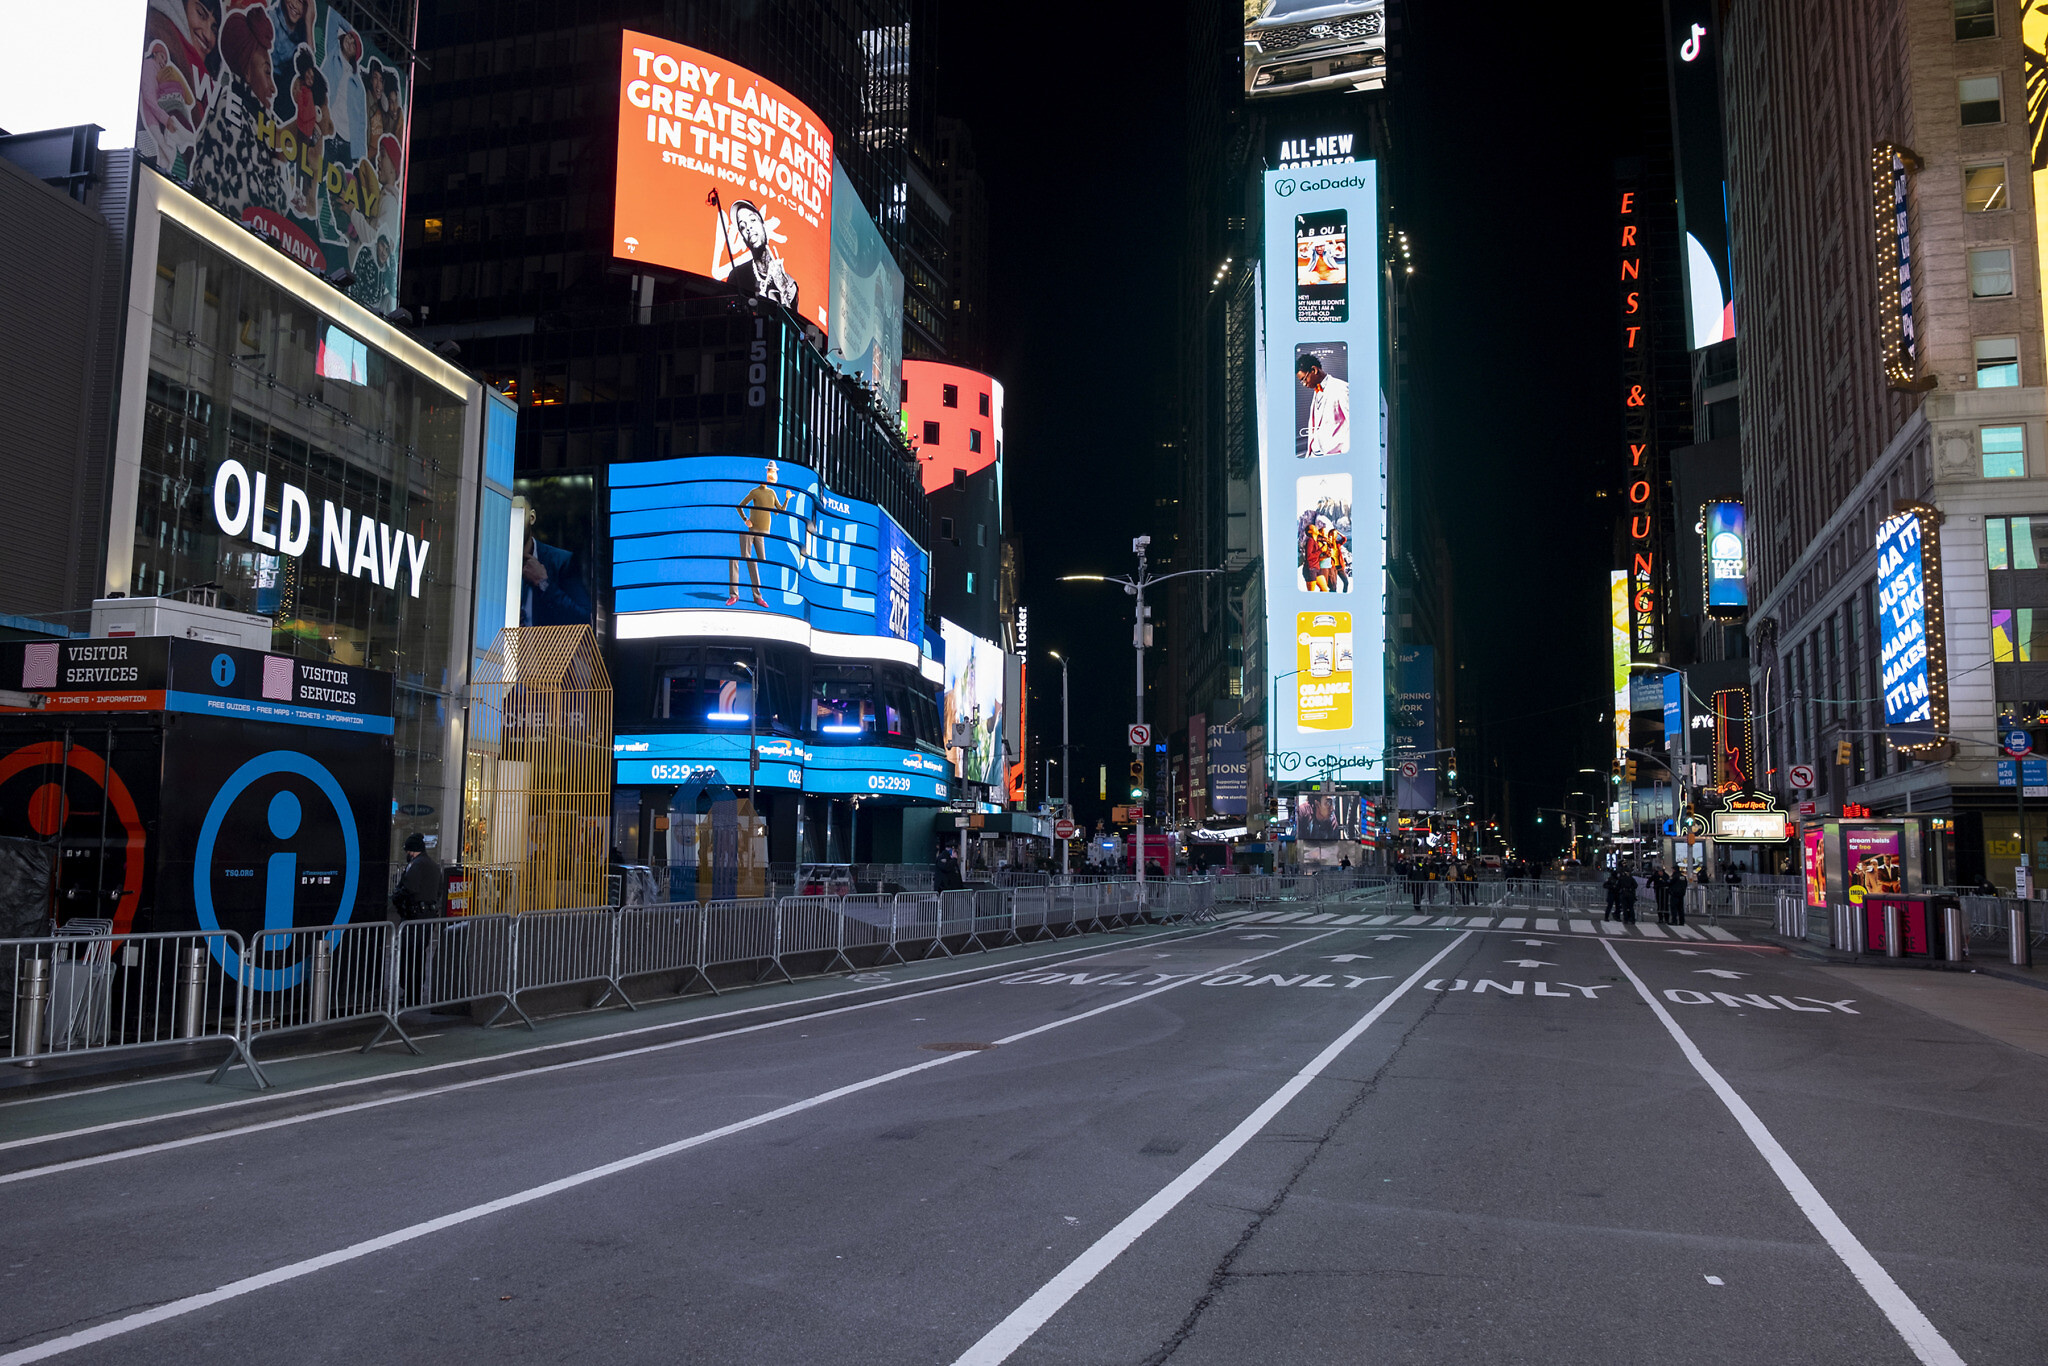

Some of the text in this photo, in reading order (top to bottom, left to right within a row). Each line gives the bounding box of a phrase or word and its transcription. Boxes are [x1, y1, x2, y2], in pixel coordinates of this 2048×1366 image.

[192, 64, 243, 129] WE
[633, 48, 831, 168] TORY LANEZ THE
[627, 79, 831, 197] GREATEST ARTIST
[1280, 134, 1353, 160] ALL-NEW
[256, 111, 379, 217] HOLIDAY
[647, 114, 824, 219] IN THE WORLD.
[662, 151, 746, 187] STREAM NOW
[1300, 175, 1366, 191] GoDaddy
[253, 215, 319, 268] OLD NAVY
[1620, 192, 1641, 348] ERNST
[748, 318, 767, 407] 1500
[214, 459, 430, 599] OLD NAVY
[1629, 443, 1654, 613] YOUNG
[1898, 517, 1921, 553] IT!
[1711, 559, 1744, 569] TACO
[1714, 568, 1745, 579] BELL
[1879, 561, 1916, 615] JUST
[889, 589, 909, 641] 2021
[68, 645, 129, 661] VISITOR
[1881, 618, 1922, 666] MAMA
[66, 667, 138, 682] SERVICES
[300, 665, 349, 685] VISITOR
[1882, 639, 1927, 690] MAKES
[300, 685, 356, 705] SERVICES
[1300, 682, 1350, 696] ORANGE
[1300, 695, 1333, 708] CORN
[1887, 682, 1910, 716] IT!
[207, 700, 364, 725] FREE GUIDES FREE MAPS TICKETS INFORMATION
[1305, 754, 1375, 770] GoDaddy
[868, 775, 911, 791] 05:29:39
[1733, 801, 1766, 809] Hard Rock
[1986, 840, 2020, 855] 150
[225, 869, 254, 877] TSQ.ORG
[448, 882, 472, 893] JERSEY
[1000, 972, 1206, 986] ONLY
[1201, 973, 1396, 989] ONLY
[1423, 978, 1613, 999] ONLY
[1662, 988, 1862, 1015] ONLY
